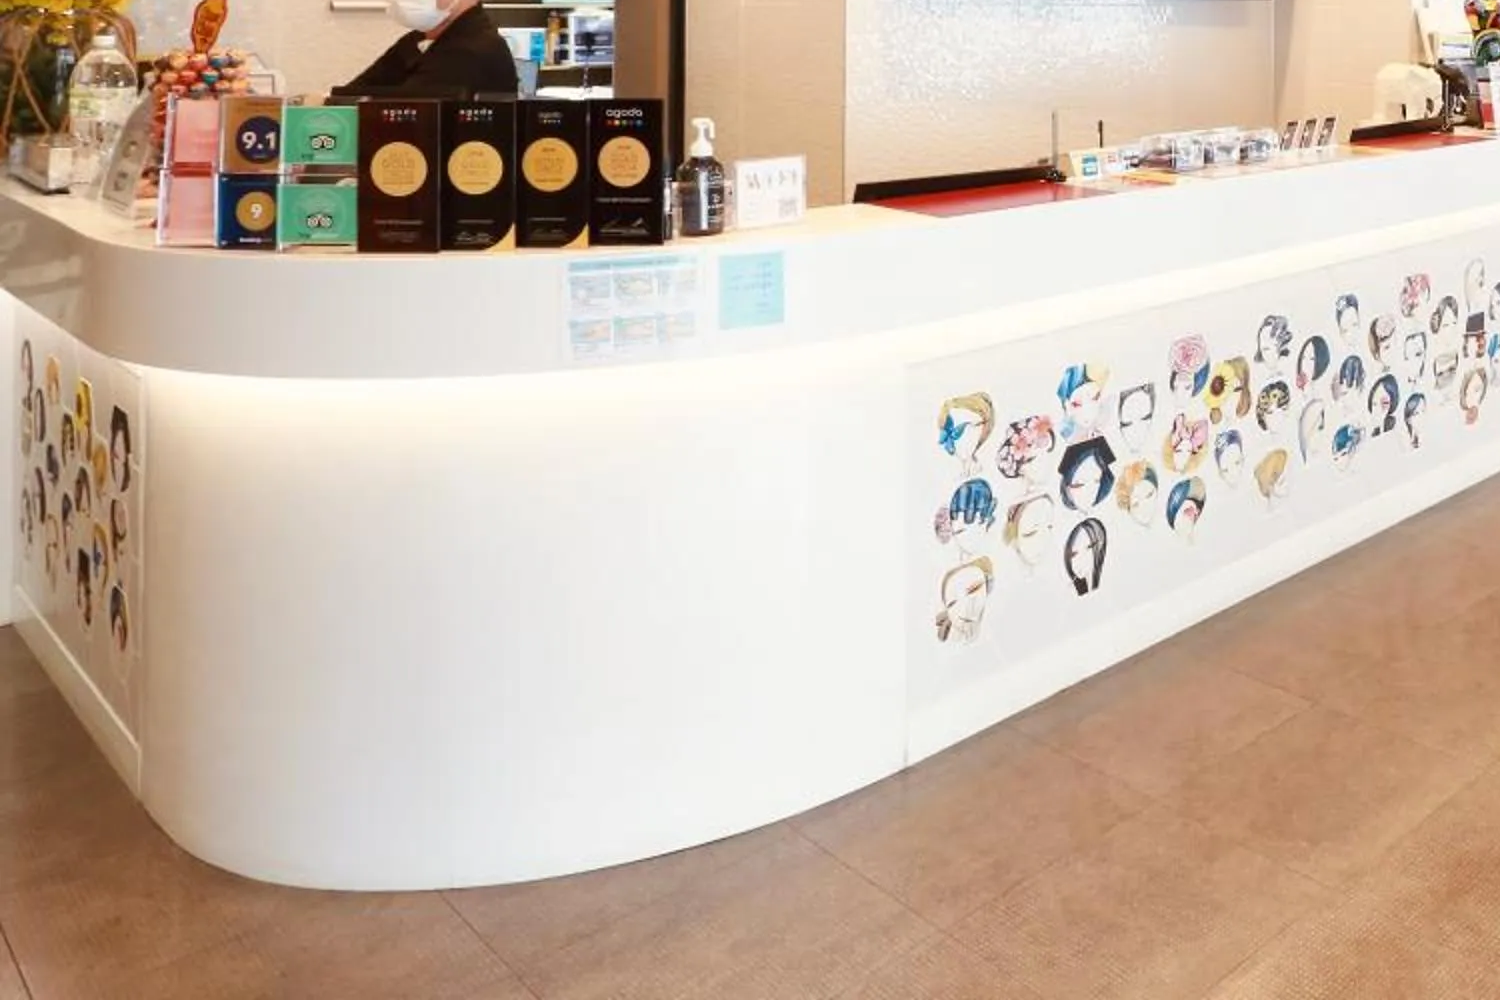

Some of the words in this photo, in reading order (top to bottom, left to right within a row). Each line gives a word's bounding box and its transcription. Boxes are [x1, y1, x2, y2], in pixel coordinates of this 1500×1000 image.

[605, 108, 643, 118] agoda
[241, 131, 277, 150] 9.1
[250, 203, 263, 219] 9
